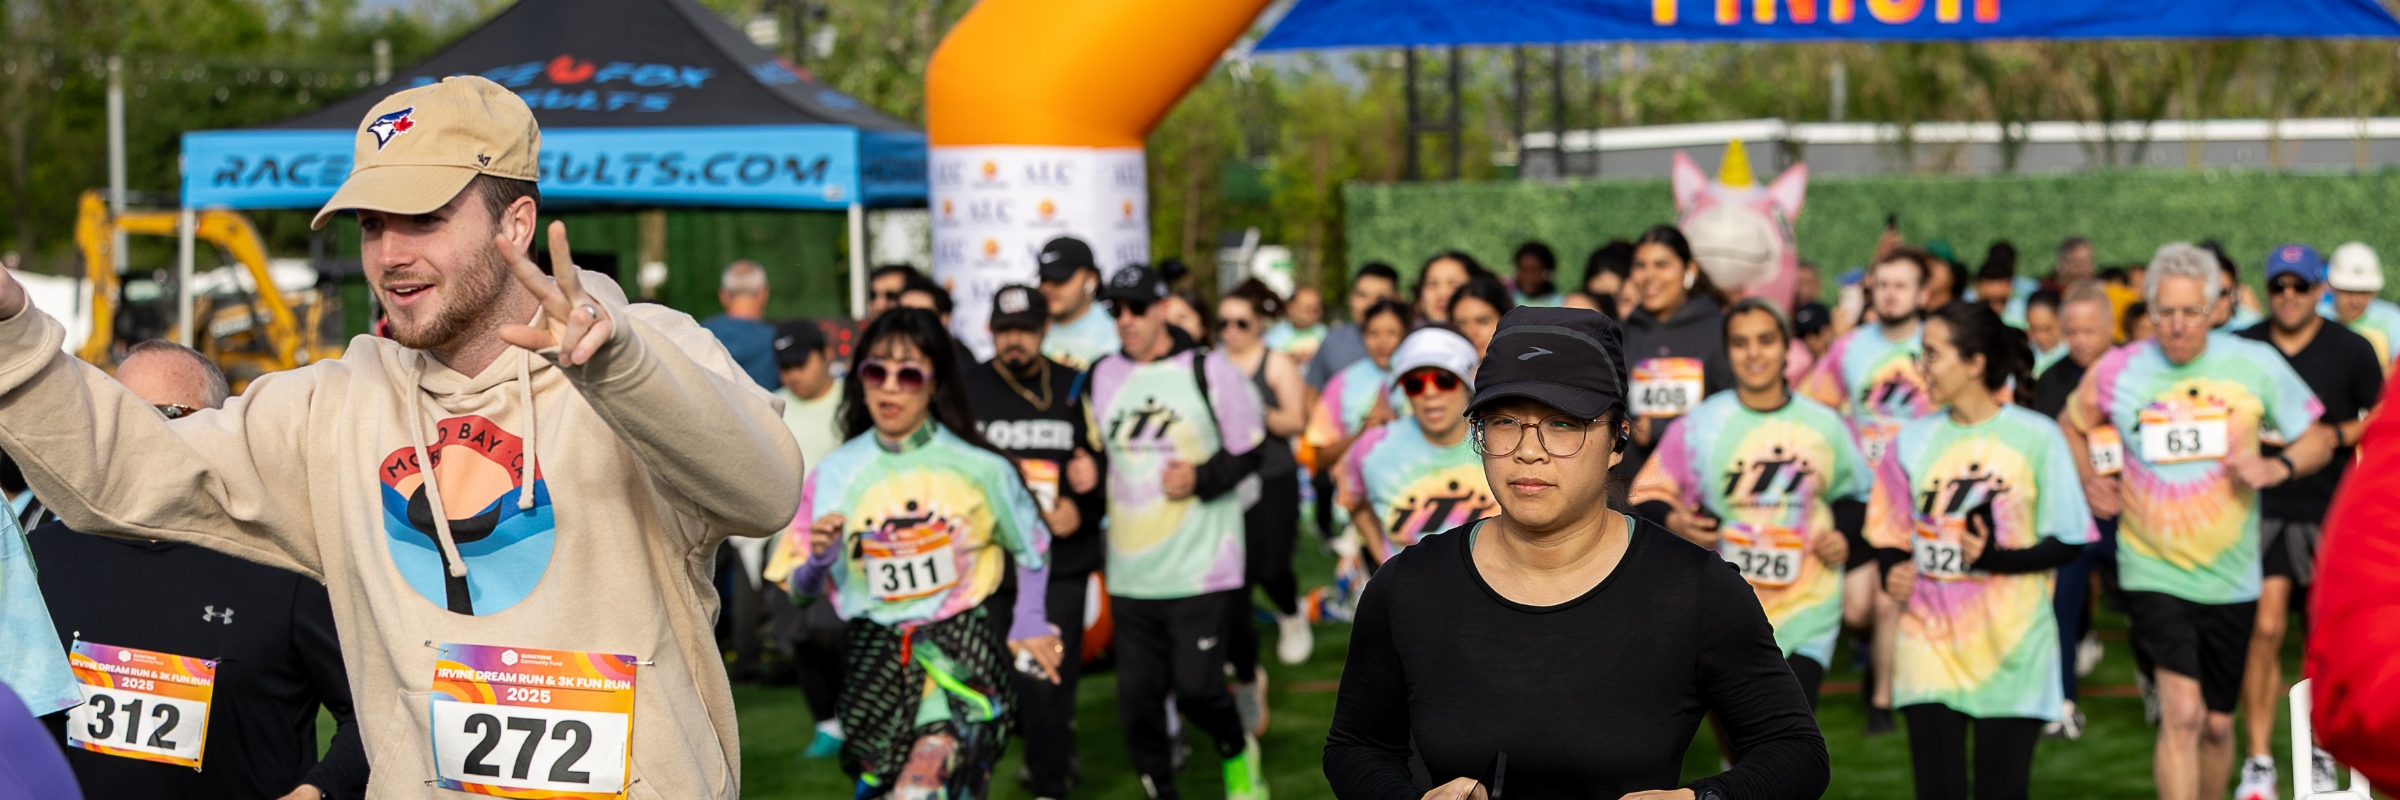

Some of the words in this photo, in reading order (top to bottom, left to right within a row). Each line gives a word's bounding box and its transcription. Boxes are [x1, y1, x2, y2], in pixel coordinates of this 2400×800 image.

[975, 418, 1075, 450] OSER
[2167, 428, 2201, 453] 63
[387, 427, 448, 479] MORO
[458, 423, 503, 453] BAY
[881, 556, 938, 592] 311
[1738, 550, 1789, 579] 326
[520, 653, 552, 661] SUNSTONE
[520, 658, 549, 667] Community
[71, 659, 98, 671] IRVINE
[98, 662, 130, 675] DREAM
[130, 667, 150, 678] RUN
[150, 670, 158, 679] &
[159, 671, 171, 681] 3K
[171, 674, 190, 684] FUN
[190, 676, 211, 687] RUN
[121, 677, 155, 691] 2025
[438, 667, 474, 680] IRVINE
[476, 670, 517, 683] DREAM
[518, 673, 544, 686] RUN
[545, 675, 556, 686] &
[557, 675, 574, 687] 3K
[576, 677, 602, 689] FUN
[604, 679, 630, 691] RUN
[506, 687, 551, 704] 2025
[87, 693, 180, 751] 312
[463, 712, 593, 784] 272
